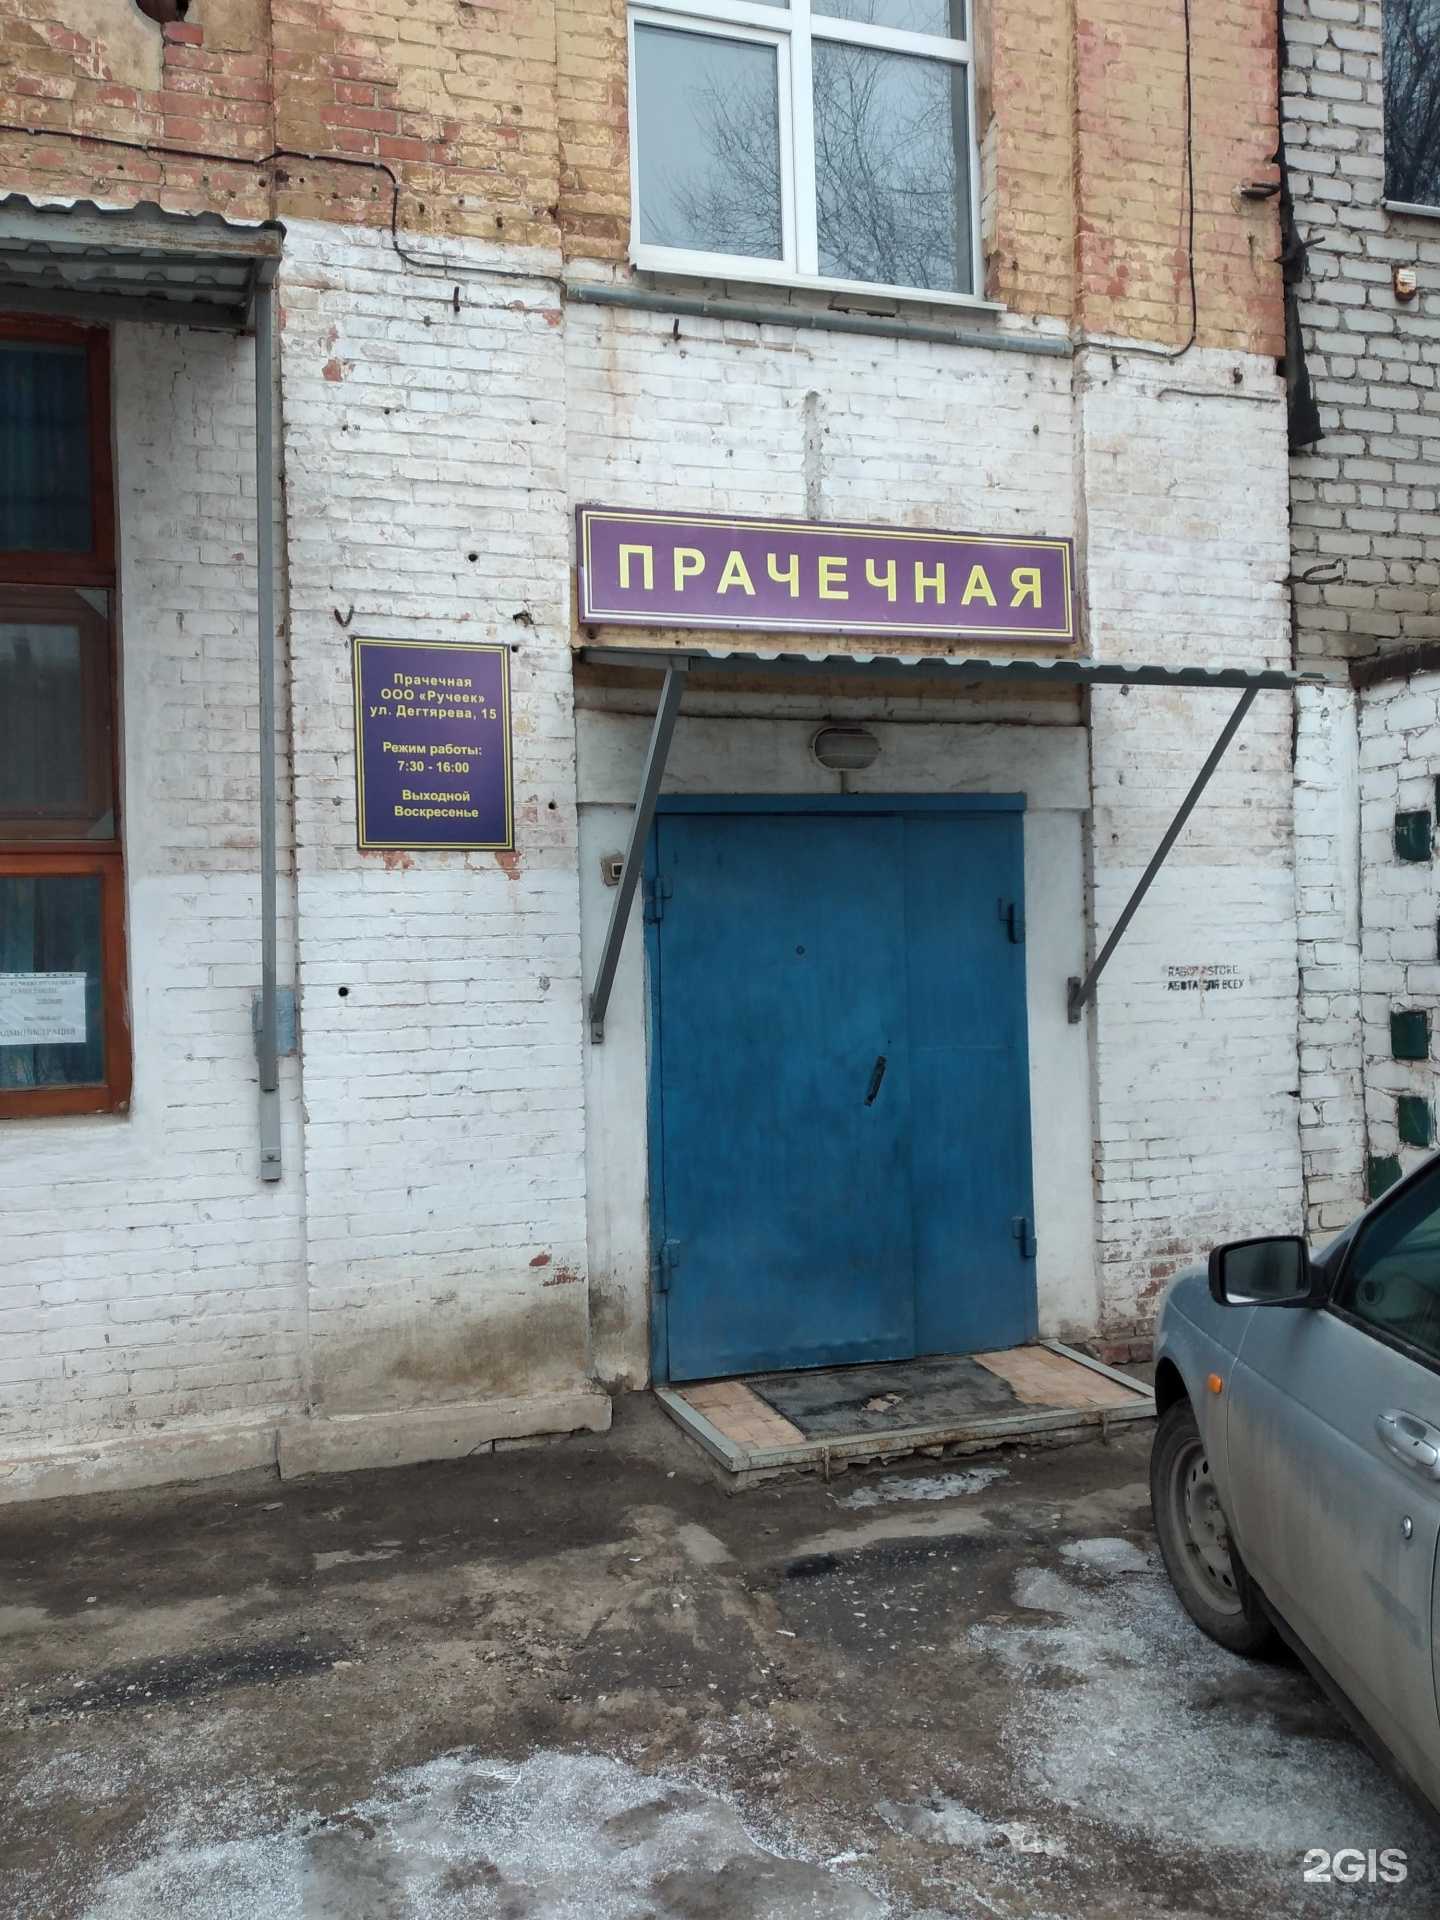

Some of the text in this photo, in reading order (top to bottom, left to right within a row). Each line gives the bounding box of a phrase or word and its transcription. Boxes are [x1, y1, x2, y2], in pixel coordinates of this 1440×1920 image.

[618, 543, 1044, 610] ПРАЧЕЧНАЯ
[394, 673, 472, 687] Прачечная
[381, 690, 485, 704] ООО «Ручеек»
[370, 706, 497, 720] ул. Дегтярева, 15
[382, 742, 482, 756] Режим работы:
[397, 761, 424, 772] 7:30
[436, 761, 469, 773] 16:00
[402, 789, 470, 802] Выходной
[394, 806, 479, 818] Воскресенье
